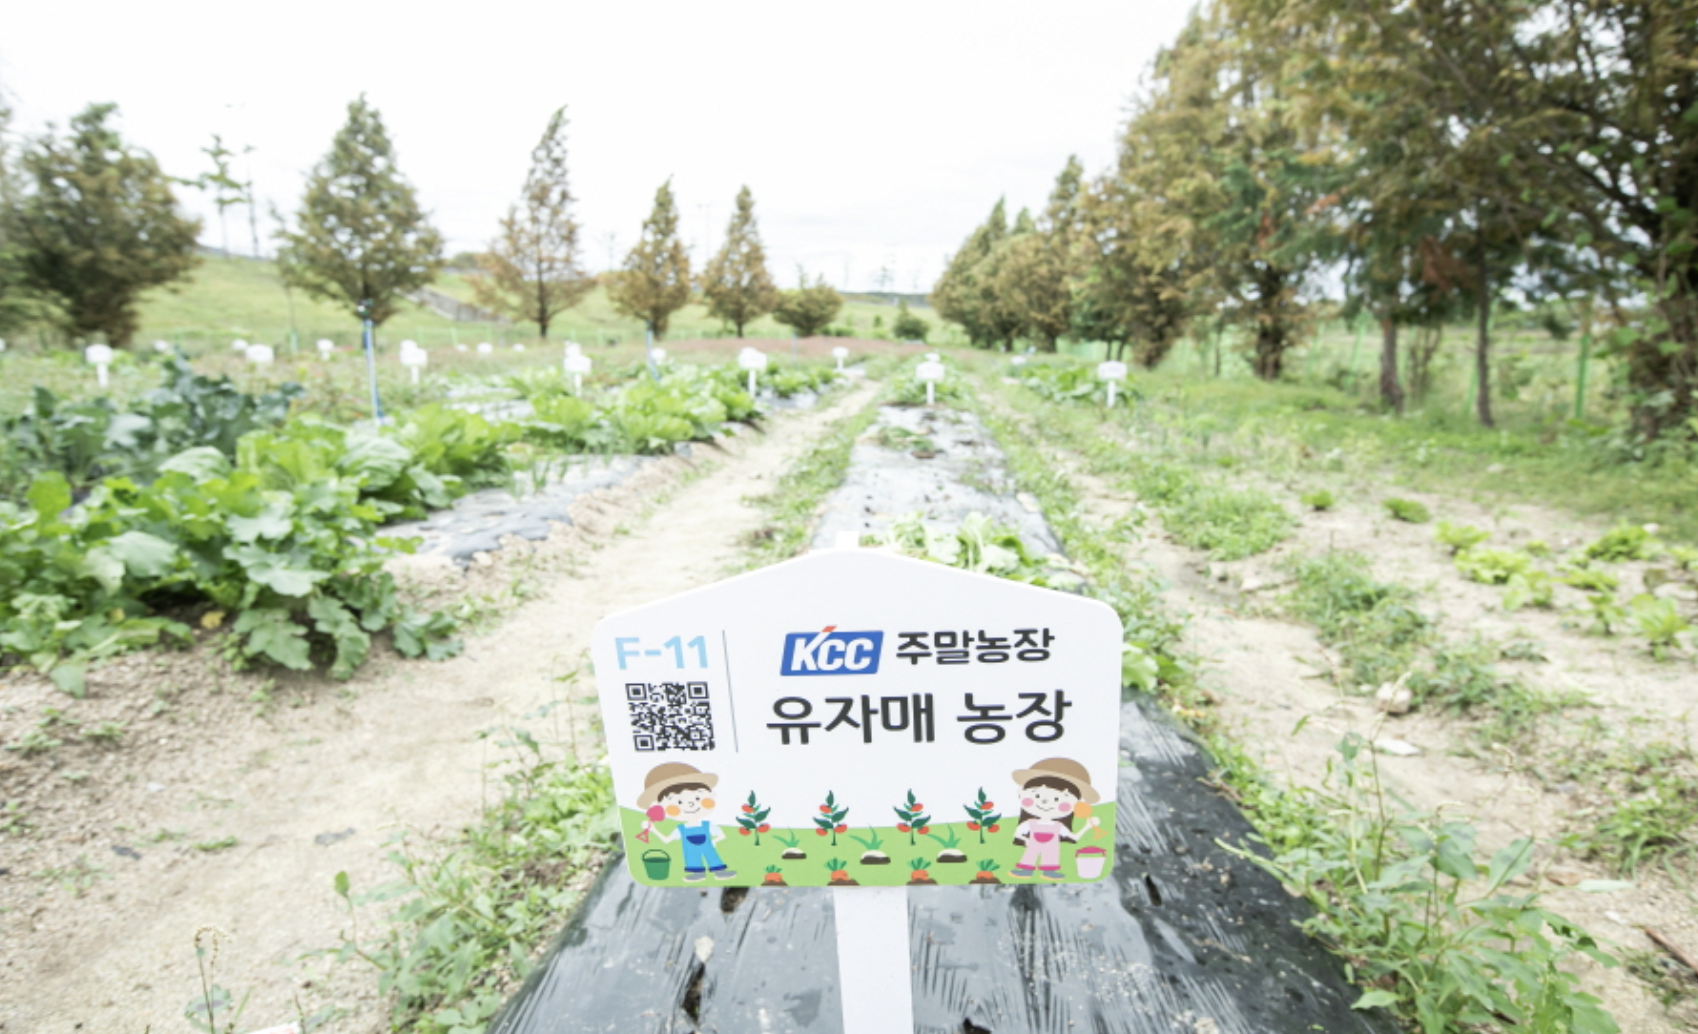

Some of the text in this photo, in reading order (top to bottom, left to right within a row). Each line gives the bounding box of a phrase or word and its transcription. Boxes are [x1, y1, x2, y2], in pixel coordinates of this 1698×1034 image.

[615, 635, 708, 670] F-11
[788, 626, 1055, 672] KCC 주말농장
[766, 689, 1073, 745] 유자매 농장
